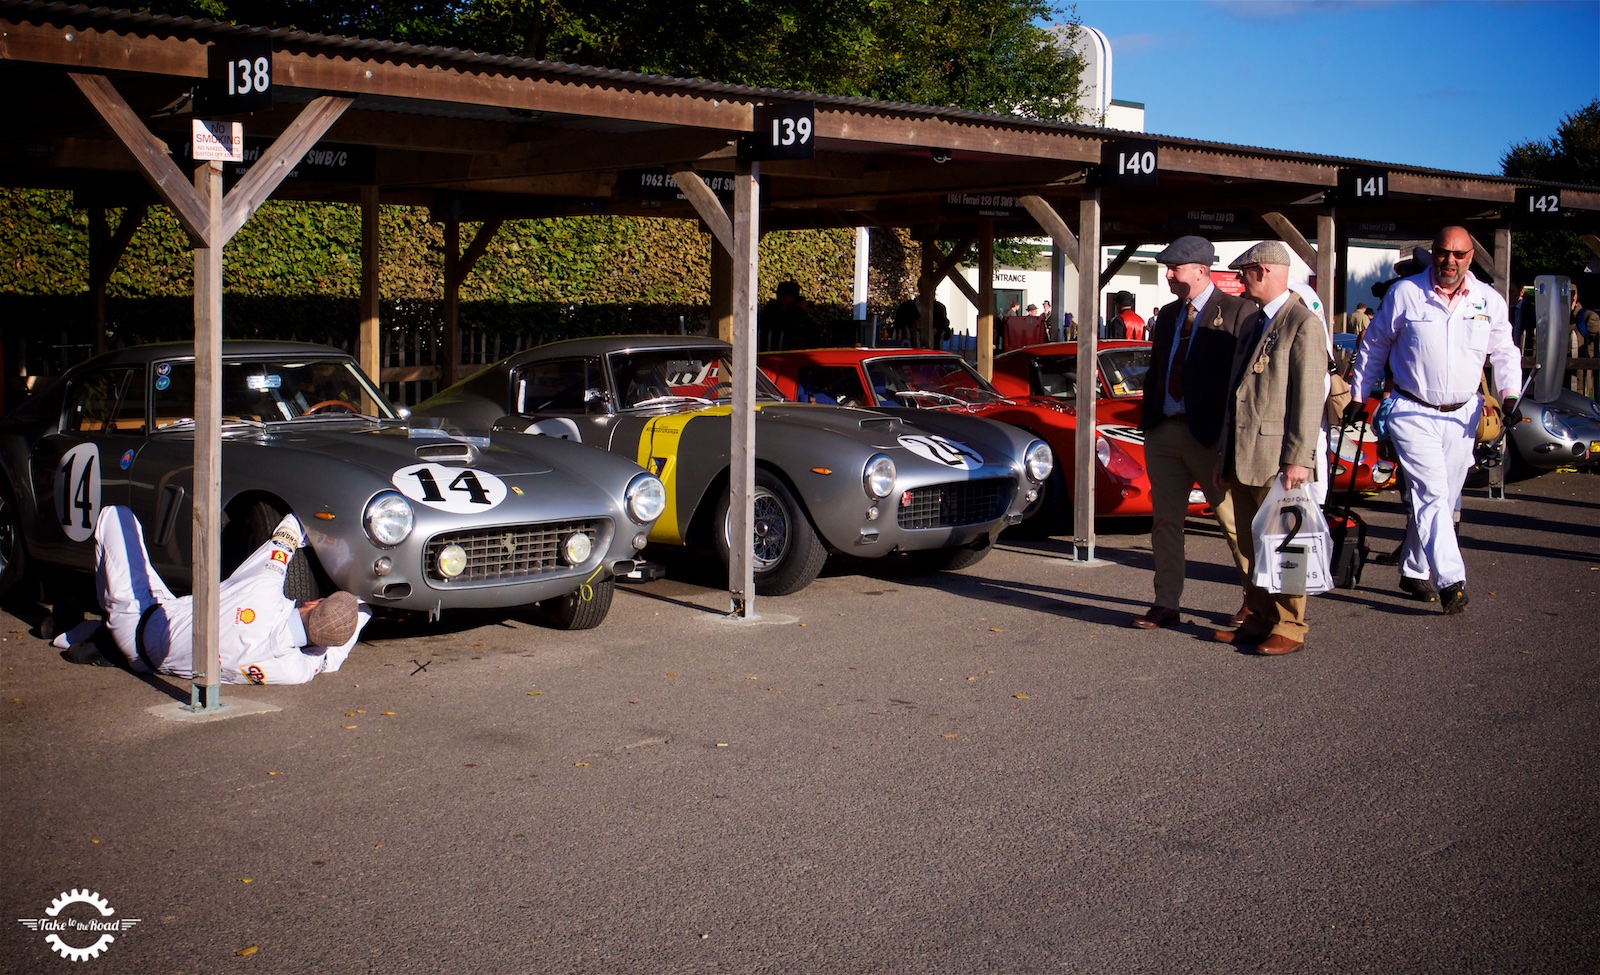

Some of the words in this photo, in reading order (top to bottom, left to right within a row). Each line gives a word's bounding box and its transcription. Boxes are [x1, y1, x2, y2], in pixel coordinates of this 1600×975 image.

[228, 56, 270, 96] 138
[195, 133, 241, 145] SMOKING
[211, 124, 226, 134] NO
[772, 117, 812, 146] 139
[306, 149, 347, 167] SWB/C
[1118, 151, 1155, 175] 140
[640, 173, 663, 187] 1962
[712, 177, 723, 191] GT
[1356, 176, 1384, 197] 141
[947, 193, 961, 204] 1961
[962, 193, 980, 206] Ferrari
[980, 195, 992, 206] 250
[992, 195, 1000, 206] GT
[1529, 195, 1559, 213] 142
[900, 433, 983, 465] 24
[61, 453, 94, 529] 14
[408, 468, 492, 505] 14
[1274, 505, 1305, 554] 2
